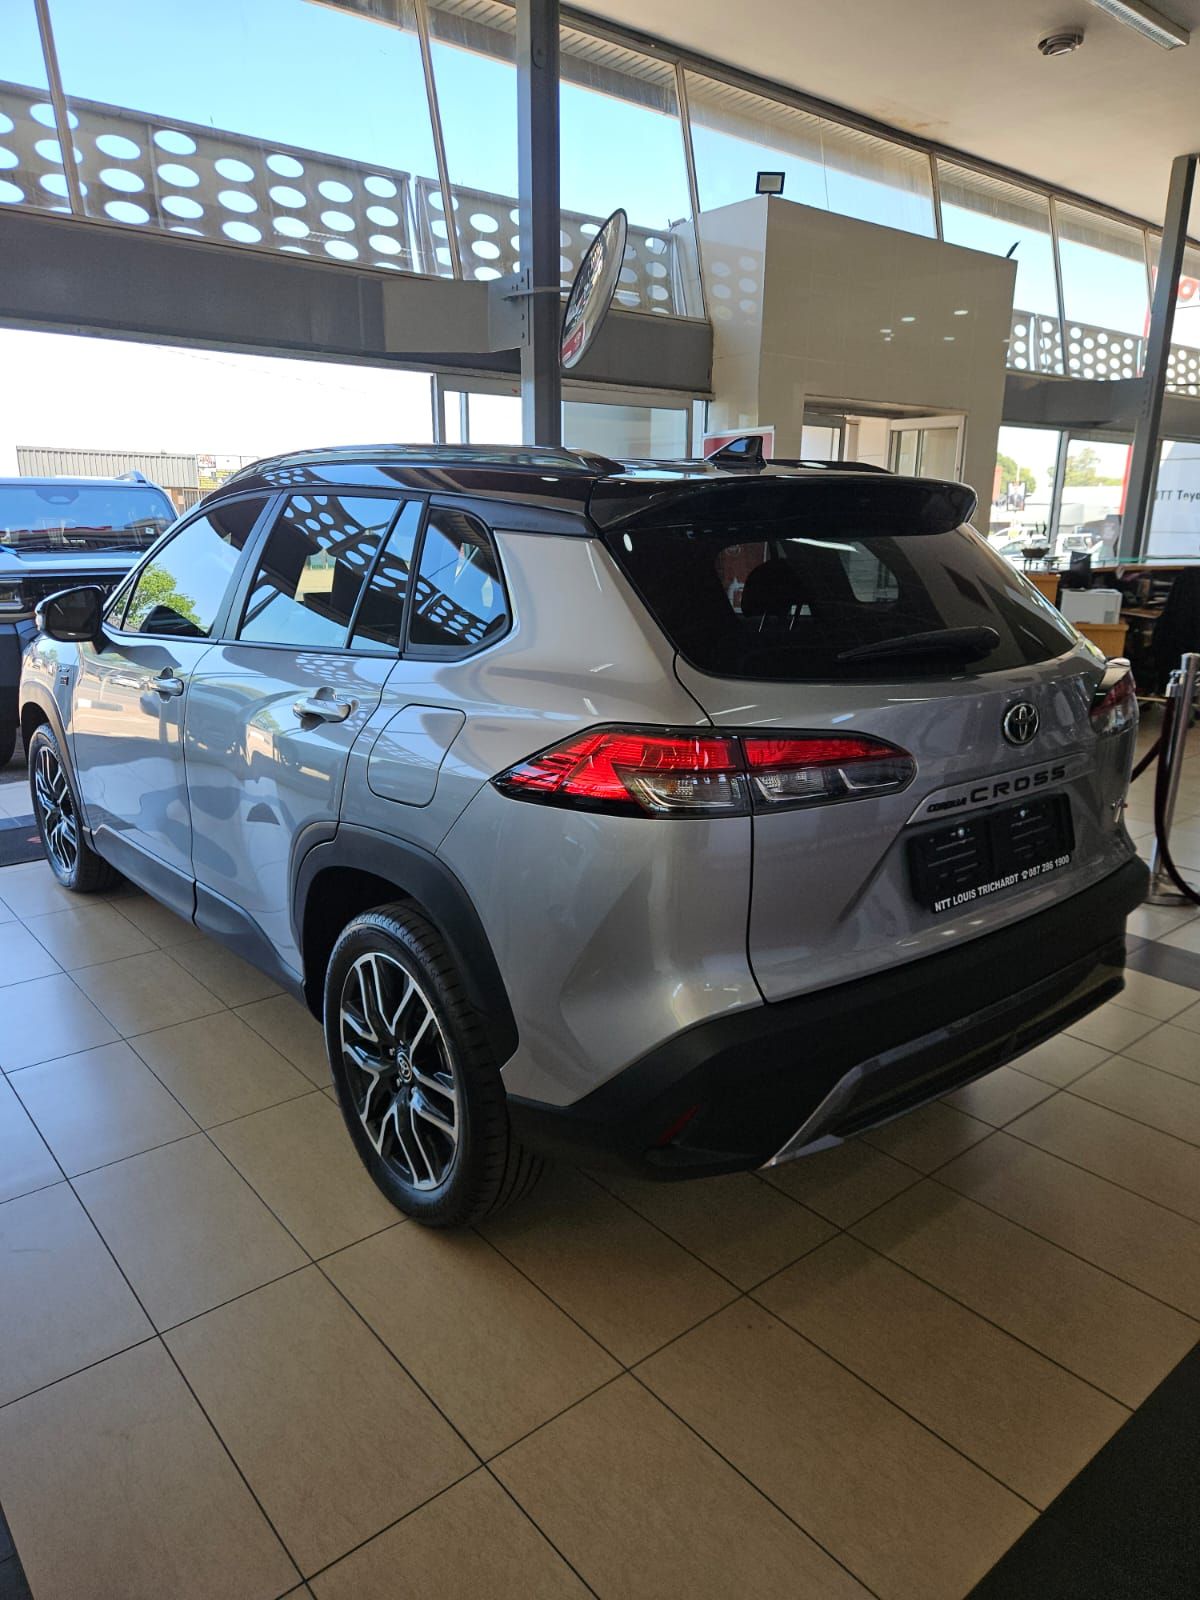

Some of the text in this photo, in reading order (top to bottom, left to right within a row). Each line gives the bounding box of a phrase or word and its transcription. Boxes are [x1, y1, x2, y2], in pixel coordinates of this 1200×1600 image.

[970, 765, 1066, 803] CROSS
[934, 897, 952, 912] NTT
[952, 889, 977, 906] LOUIS
[977, 873, 1020, 896] TRICHARDT
